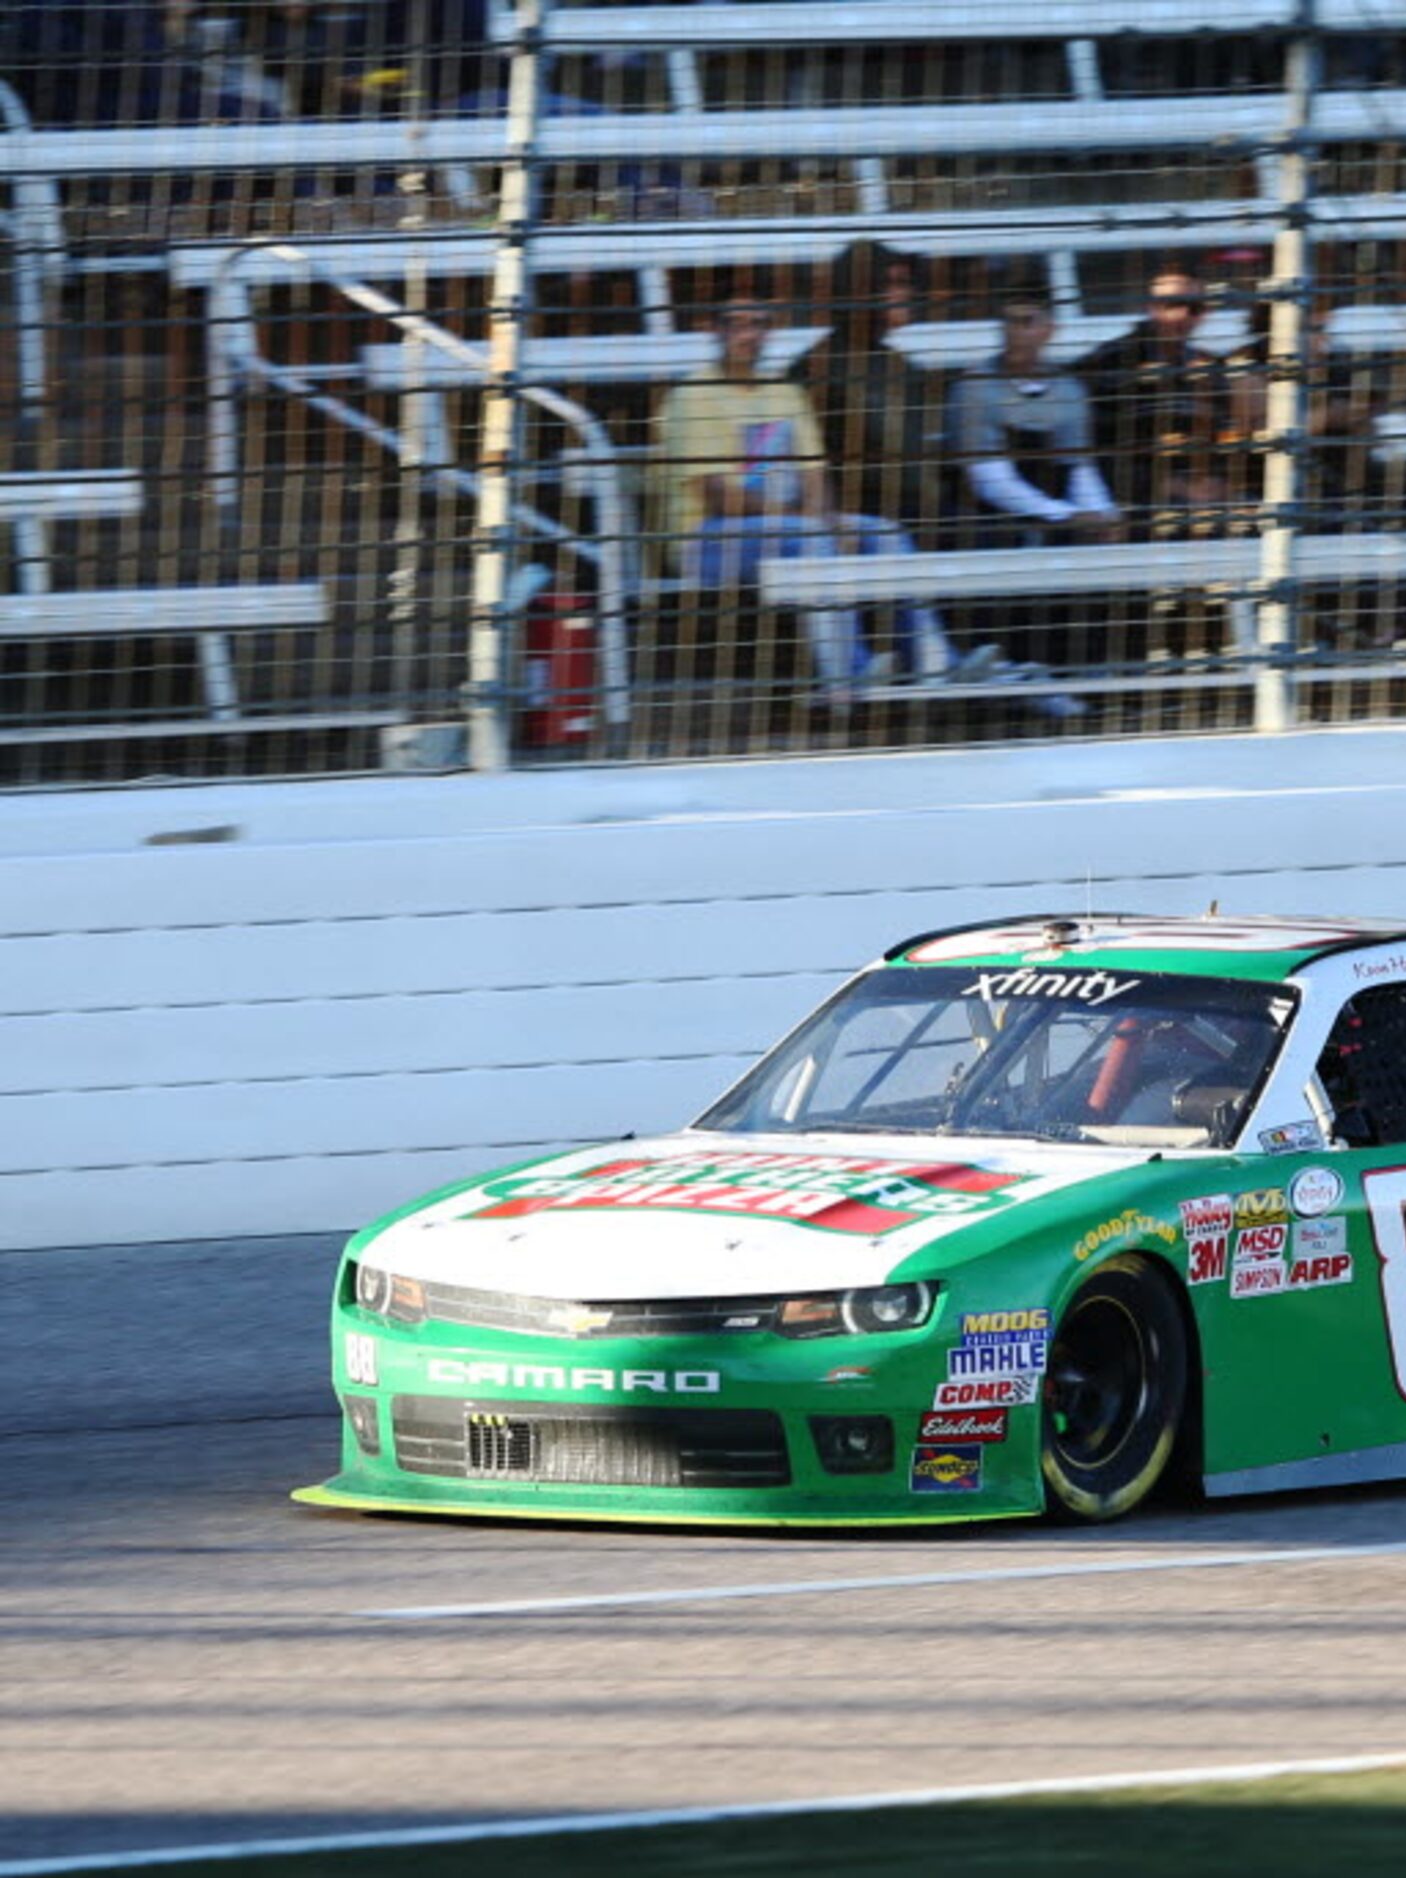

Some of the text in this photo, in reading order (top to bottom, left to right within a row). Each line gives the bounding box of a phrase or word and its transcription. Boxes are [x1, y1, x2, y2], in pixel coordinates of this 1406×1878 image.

[961, 966, 1142, 1006] xfinity
[555, 1183, 847, 1216] PIZZA
[1239, 1226, 1284, 1255] MSD
[1190, 1237, 1225, 1282] 3M
[1289, 1255, 1350, 1284] ARP
[1235, 1269, 1281, 1293] SIMPSON
[963, 1308, 1048, 1334] MOOG
[345, 1332, 378, 1385] 88
[951, 1341, 1045, 1375] MAHLE
[427, 1359, 720, 1393] CAMARO
[940, 1381, 1013, 1405] COMP
